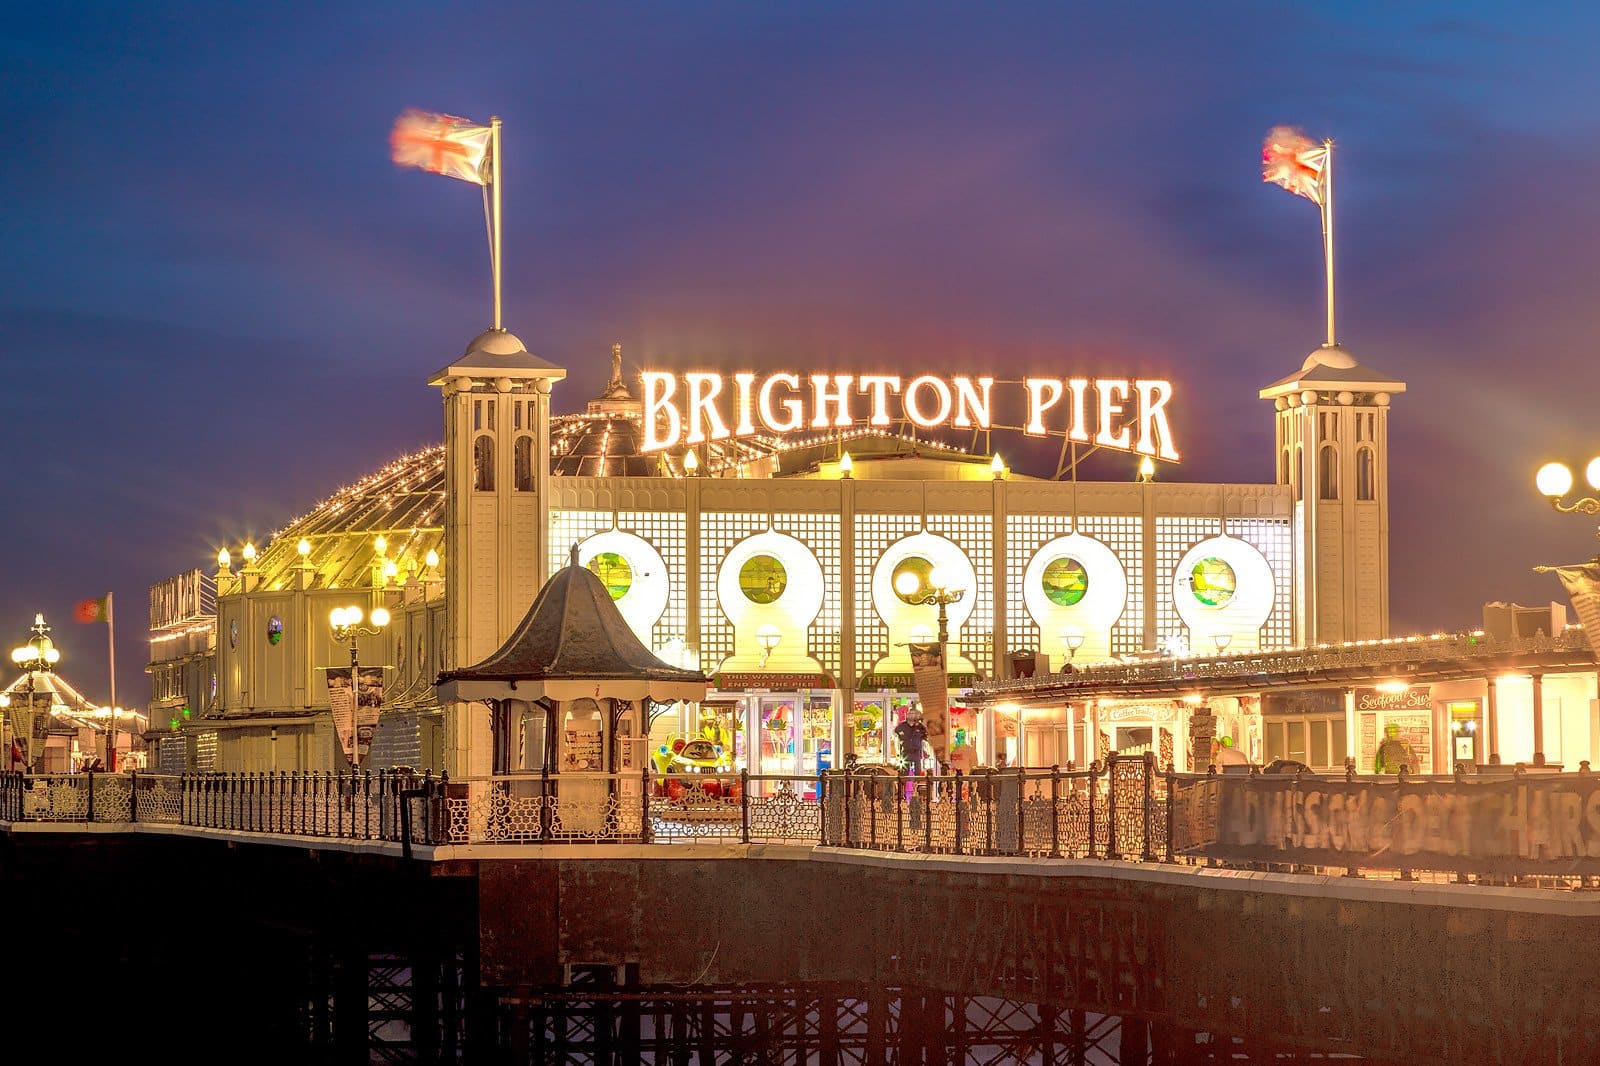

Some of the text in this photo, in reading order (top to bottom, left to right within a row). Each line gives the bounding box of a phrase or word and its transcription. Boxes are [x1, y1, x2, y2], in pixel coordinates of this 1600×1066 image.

[640, 371, 1181, 462] BRIGHTON PIER
[867, 676, 888, 686] THE
[1360, 692, 1404, 709] Seafood
